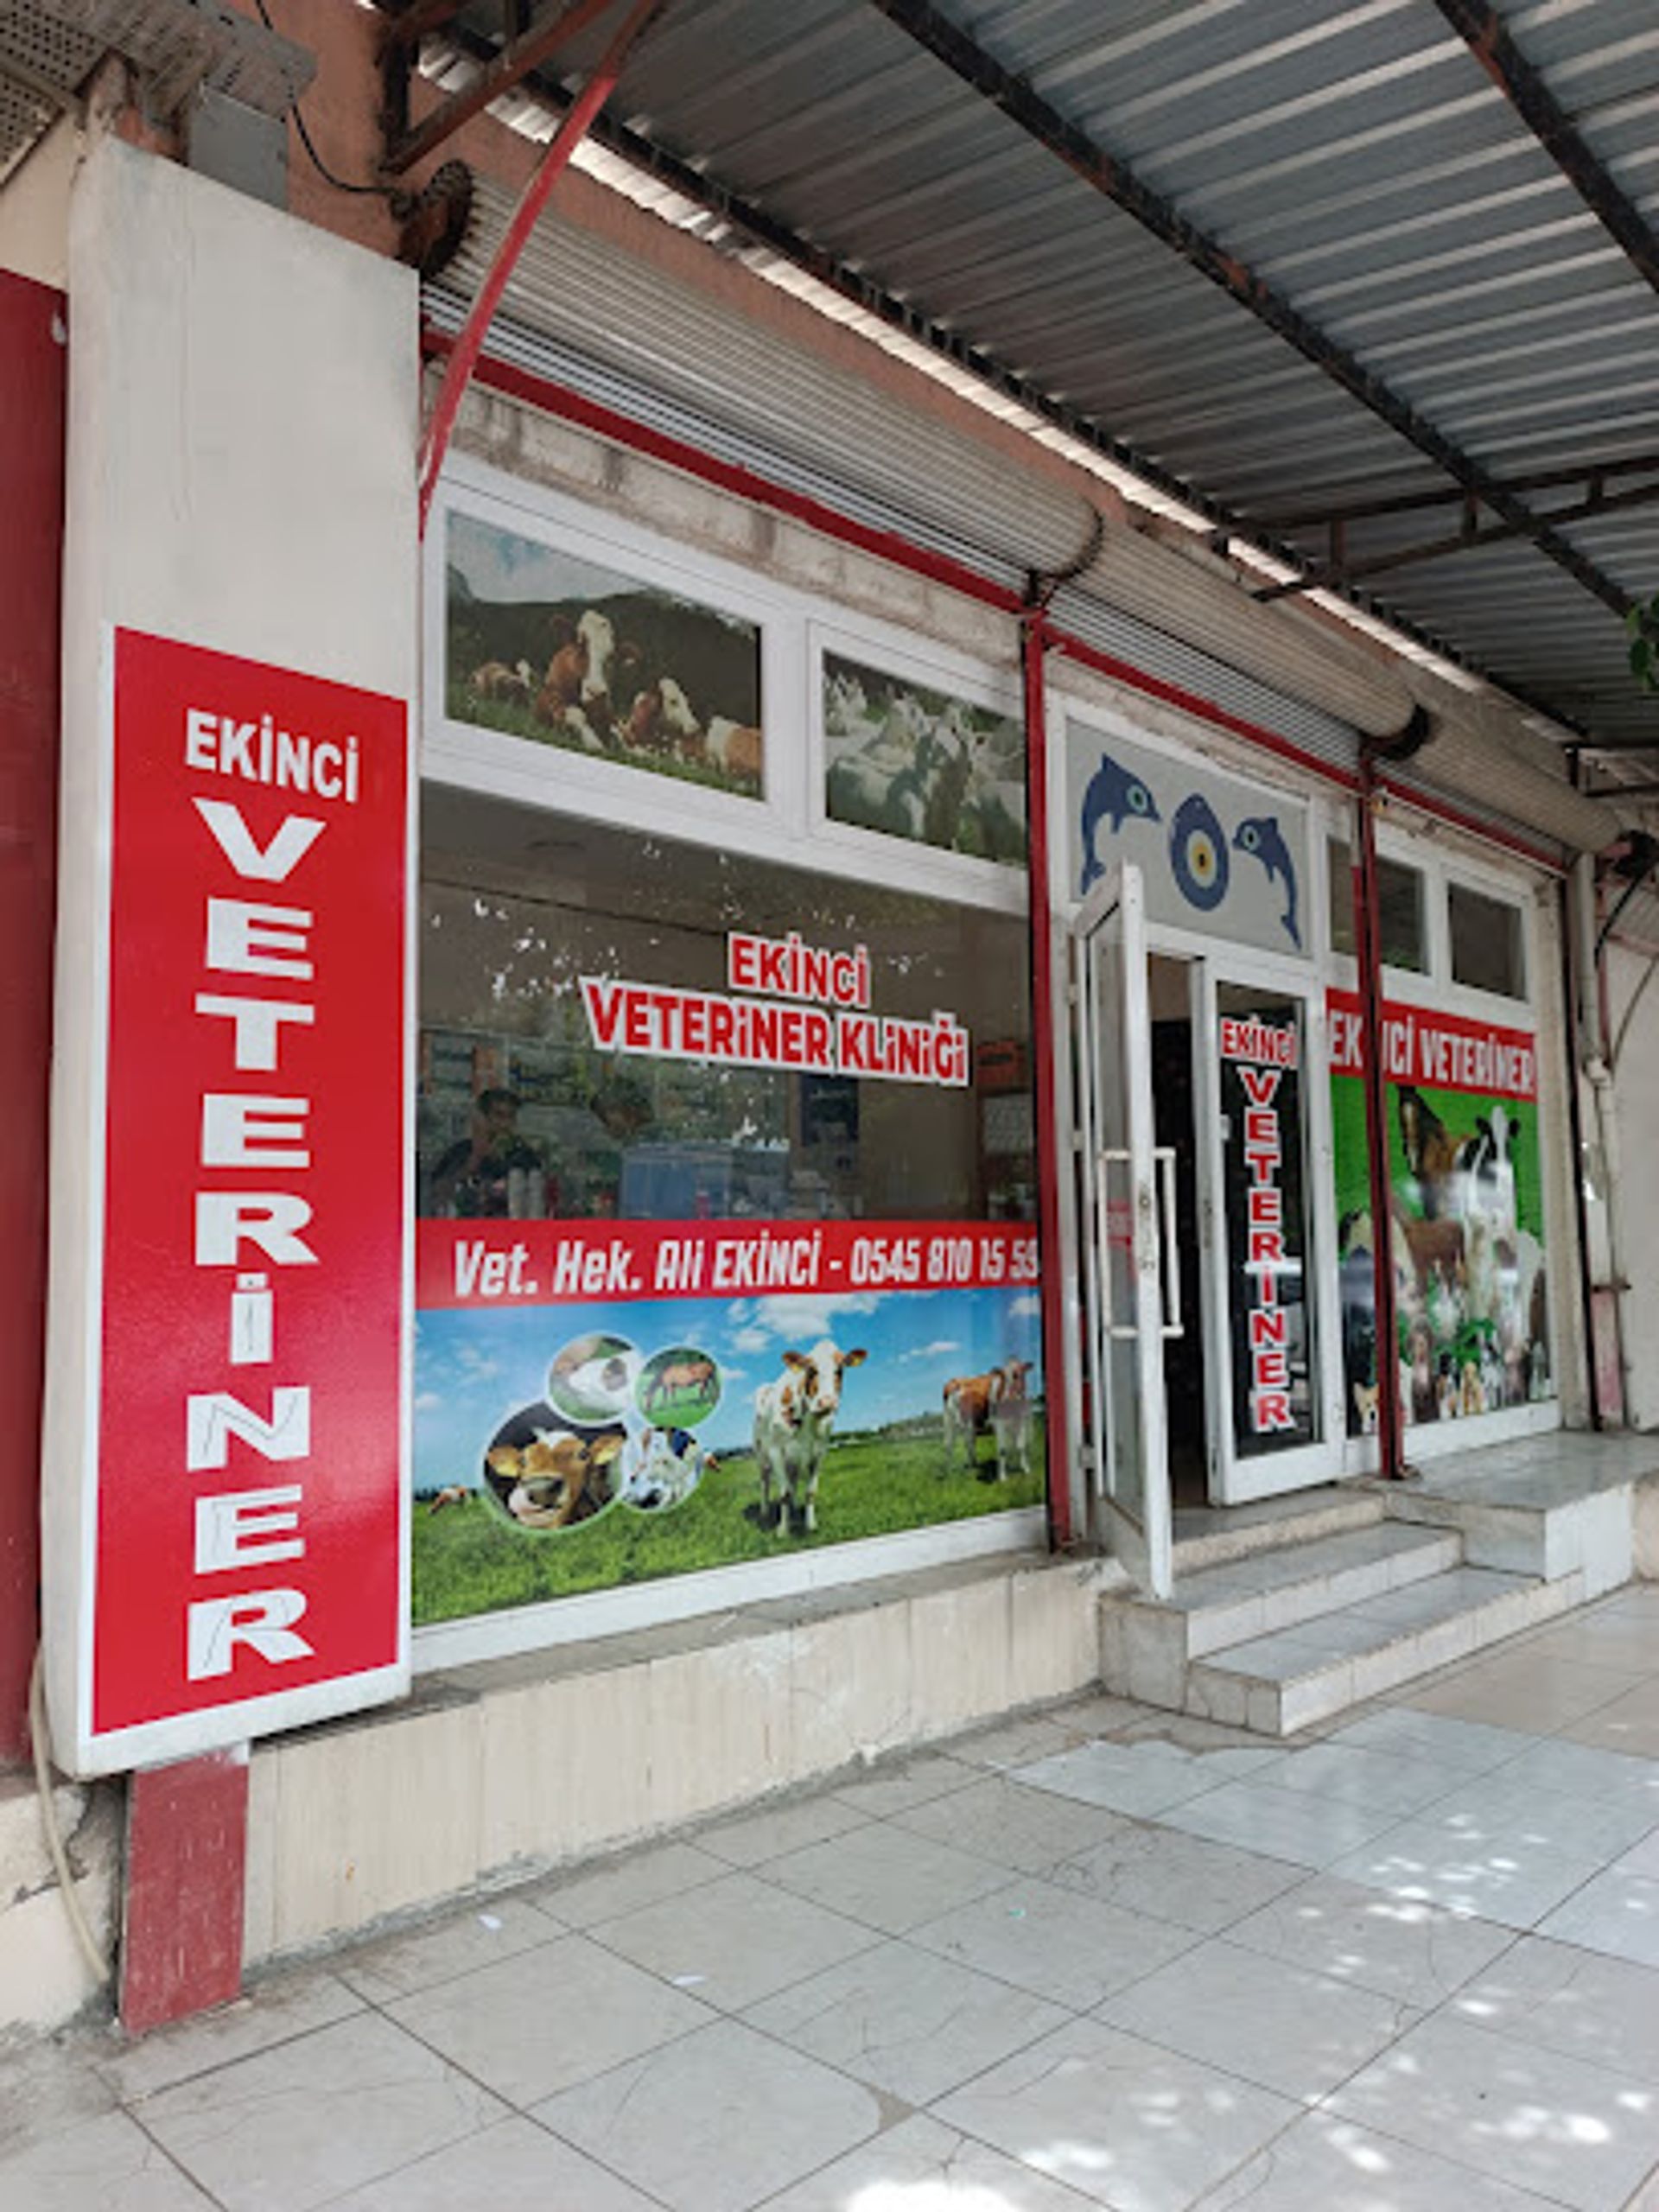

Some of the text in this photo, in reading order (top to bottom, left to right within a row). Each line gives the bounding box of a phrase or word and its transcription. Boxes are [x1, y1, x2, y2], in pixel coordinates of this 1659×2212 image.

[185, 708, 359, 803] EKİNCİ
[186, 797, 327, 1681] VETERİNER
[454, 1240, 539, 1297] Vet.
[553, 1239, 643, 1294] Hek.
[654, 1239, 704, 1291] Ali
[850, 1237, 921, 1284] 0545
[926, 1237, 974, 1282] 810
[980, 1238, 1006, 1281] 15
